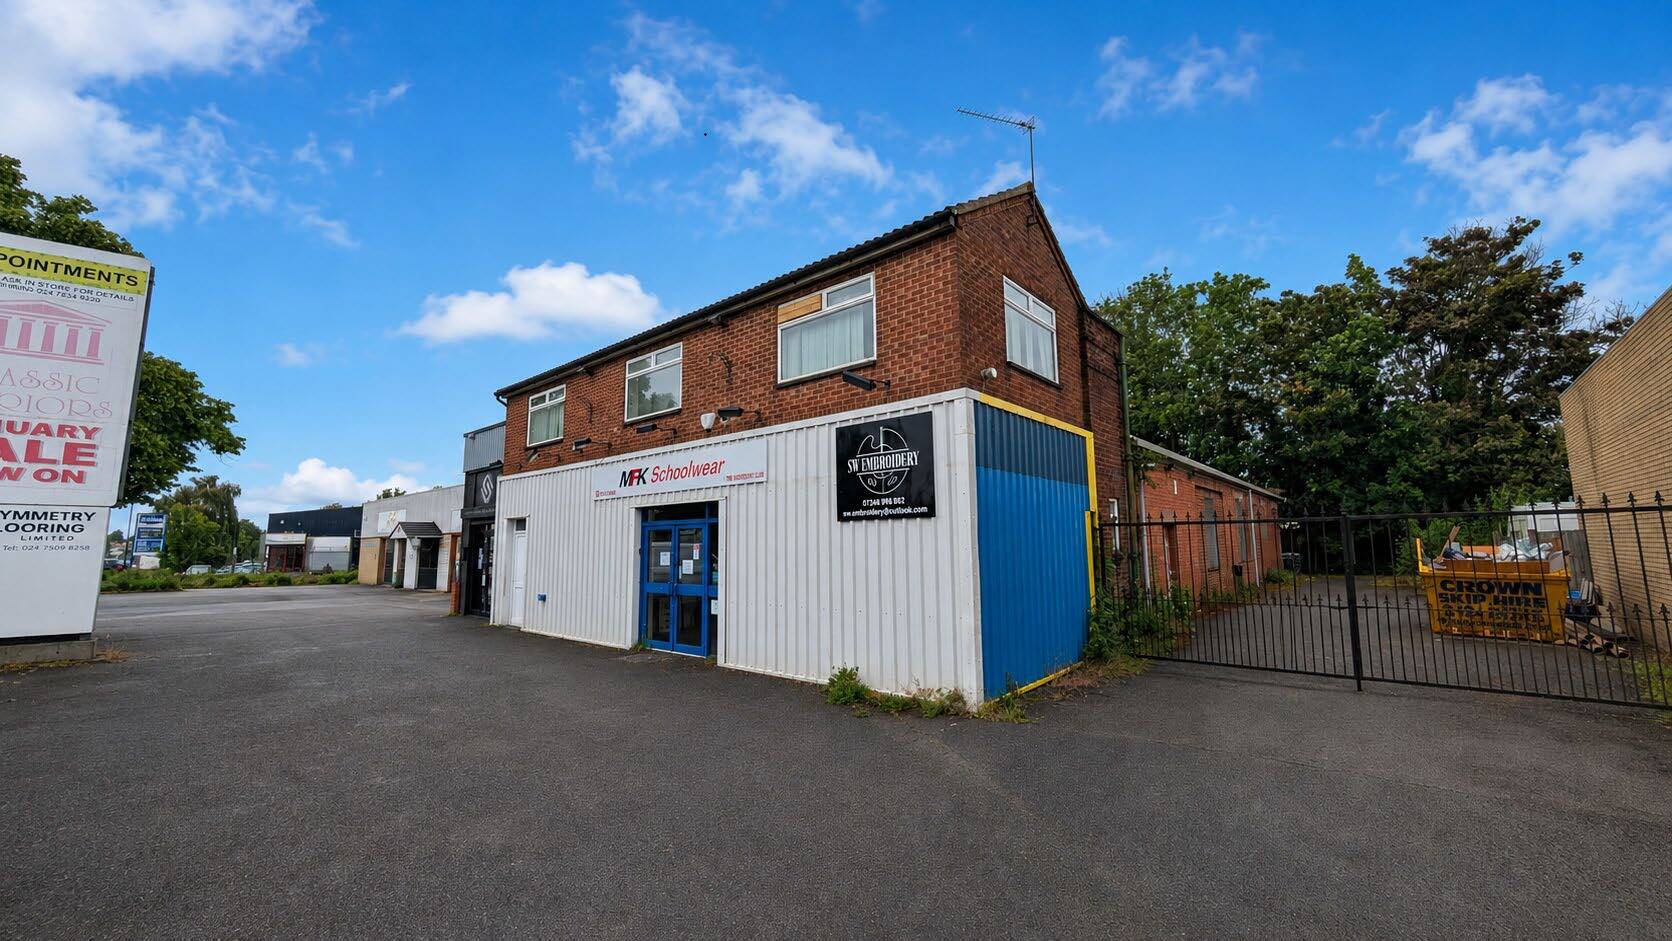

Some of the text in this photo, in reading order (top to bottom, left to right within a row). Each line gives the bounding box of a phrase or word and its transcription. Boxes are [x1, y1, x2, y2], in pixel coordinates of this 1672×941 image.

[38, 281, 70, 292] STORE
[74, 287, 93, 295] FOR
[96, 291, 134, 302] DETAILS
[0, 420, 102, 440] UARY
[847, 451, 919, 473] SW EMBROIDERY
[33, 468, 86, 484] ON
[651, 460, 725, 483] Schoolwear
[0, 522, 85, 533] OORING
[1440, 580, 1542, 595] CROWN
[1439, 592, 1487, 604] SKIP
